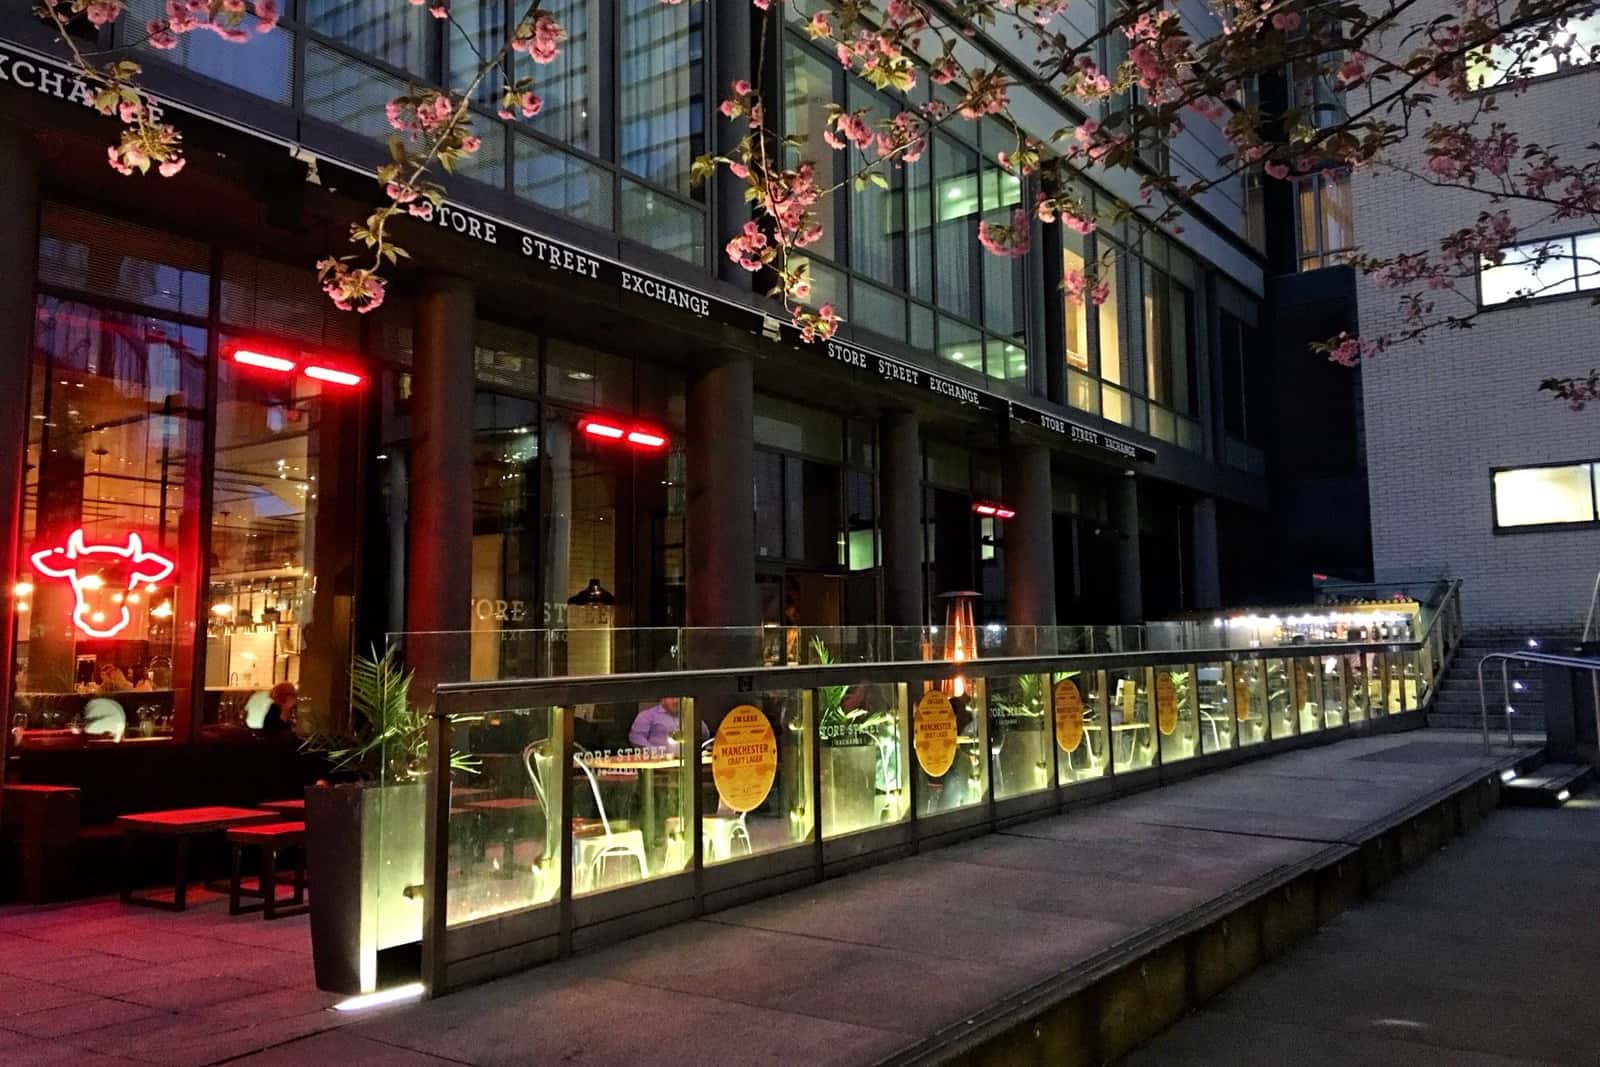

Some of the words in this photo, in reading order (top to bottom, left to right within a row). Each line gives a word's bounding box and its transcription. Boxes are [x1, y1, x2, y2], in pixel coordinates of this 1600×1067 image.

[521, 236, 600, 279] STREET
[621, 271, 710, 316] EXCHANGE
[828, 342, 867, 369] STORE
[878, 359, 919, 385] STREET
[929, 377, 980, 404] EXCHANGE
[1041, 415, 1065, 434] STORE
[1071, 425, 1098, 444] STREET
[471, 598, 525, 622] ORE
[721, 743, 769, 757] MANCHESTER
